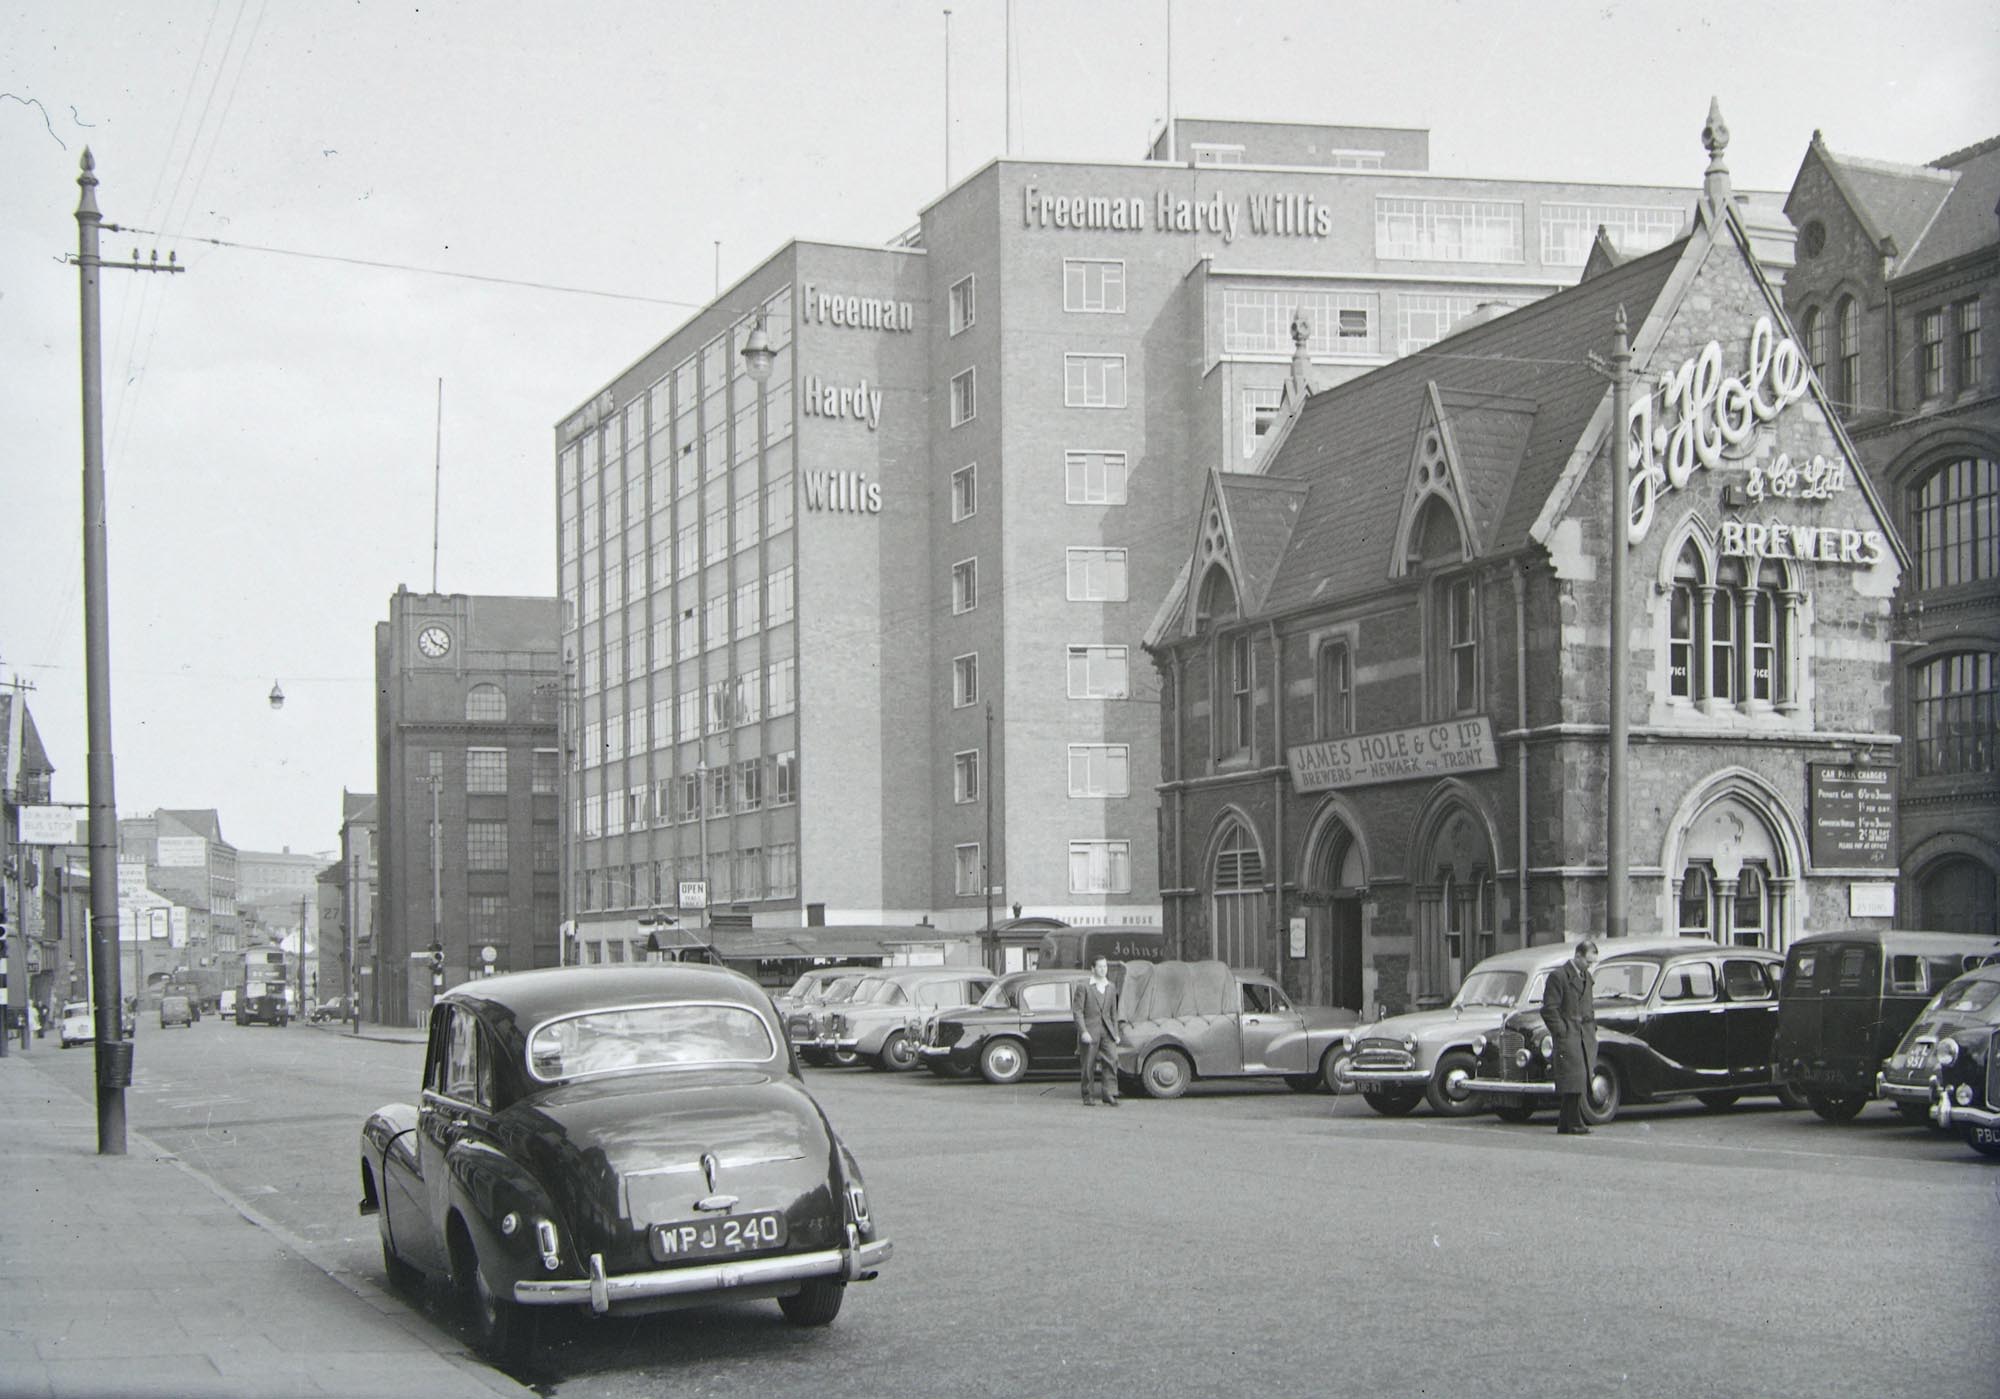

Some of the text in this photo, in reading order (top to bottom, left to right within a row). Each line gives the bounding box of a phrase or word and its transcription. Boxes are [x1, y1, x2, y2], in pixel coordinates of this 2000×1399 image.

[1024, 184, 1333, 243] Freeman Hardy Willis
[804, 282, 913, 331] Freeman
[804, 376, 882, 431] Hardy
[804, 470, 882, 512] Willis
[1721, 520, 1884, 564] BREWERS
[1297, 742, 1351, 770] JAMES
[1359, 734, 1409, 762] HOLE
[1413, 736, 1425, 754] &
[1302, 767, 1352, 787] BREWERS
[1369, 756, 1422, 778] NEWARK
[1441, 747, 1482, 768] TRENT
[1821, 769, 1887, 780] CAR PARK CHARGES
[681, 883, 704, 894] OPEN
[1122, 915, 1153, 925] HOUSE
[659, 1216, 778, 1254] WPJ 240
